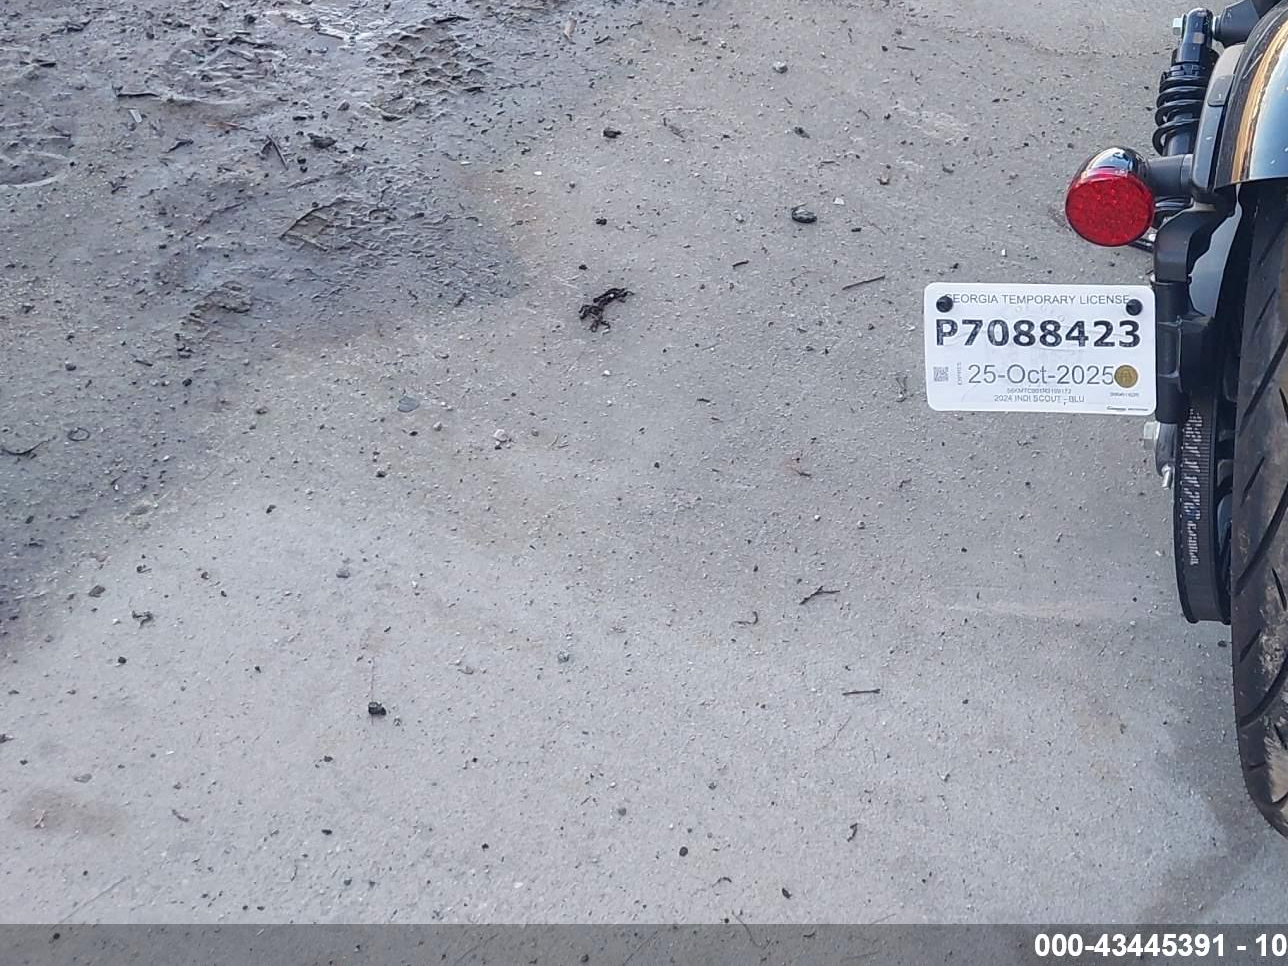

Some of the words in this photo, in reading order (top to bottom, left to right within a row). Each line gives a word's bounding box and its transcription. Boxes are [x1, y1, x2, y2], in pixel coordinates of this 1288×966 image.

[1002, 294, 1075, 305] TEMPORARY
[1079, 295, 1130, 306] LICENSE
[936, 319, 1140, 348] P7088423
[968, 364, 1115, 385] 25-Oct-2025
[994, 394, 1012, 402] 2024
[1033, 395, 1060, 403] SCOUT
